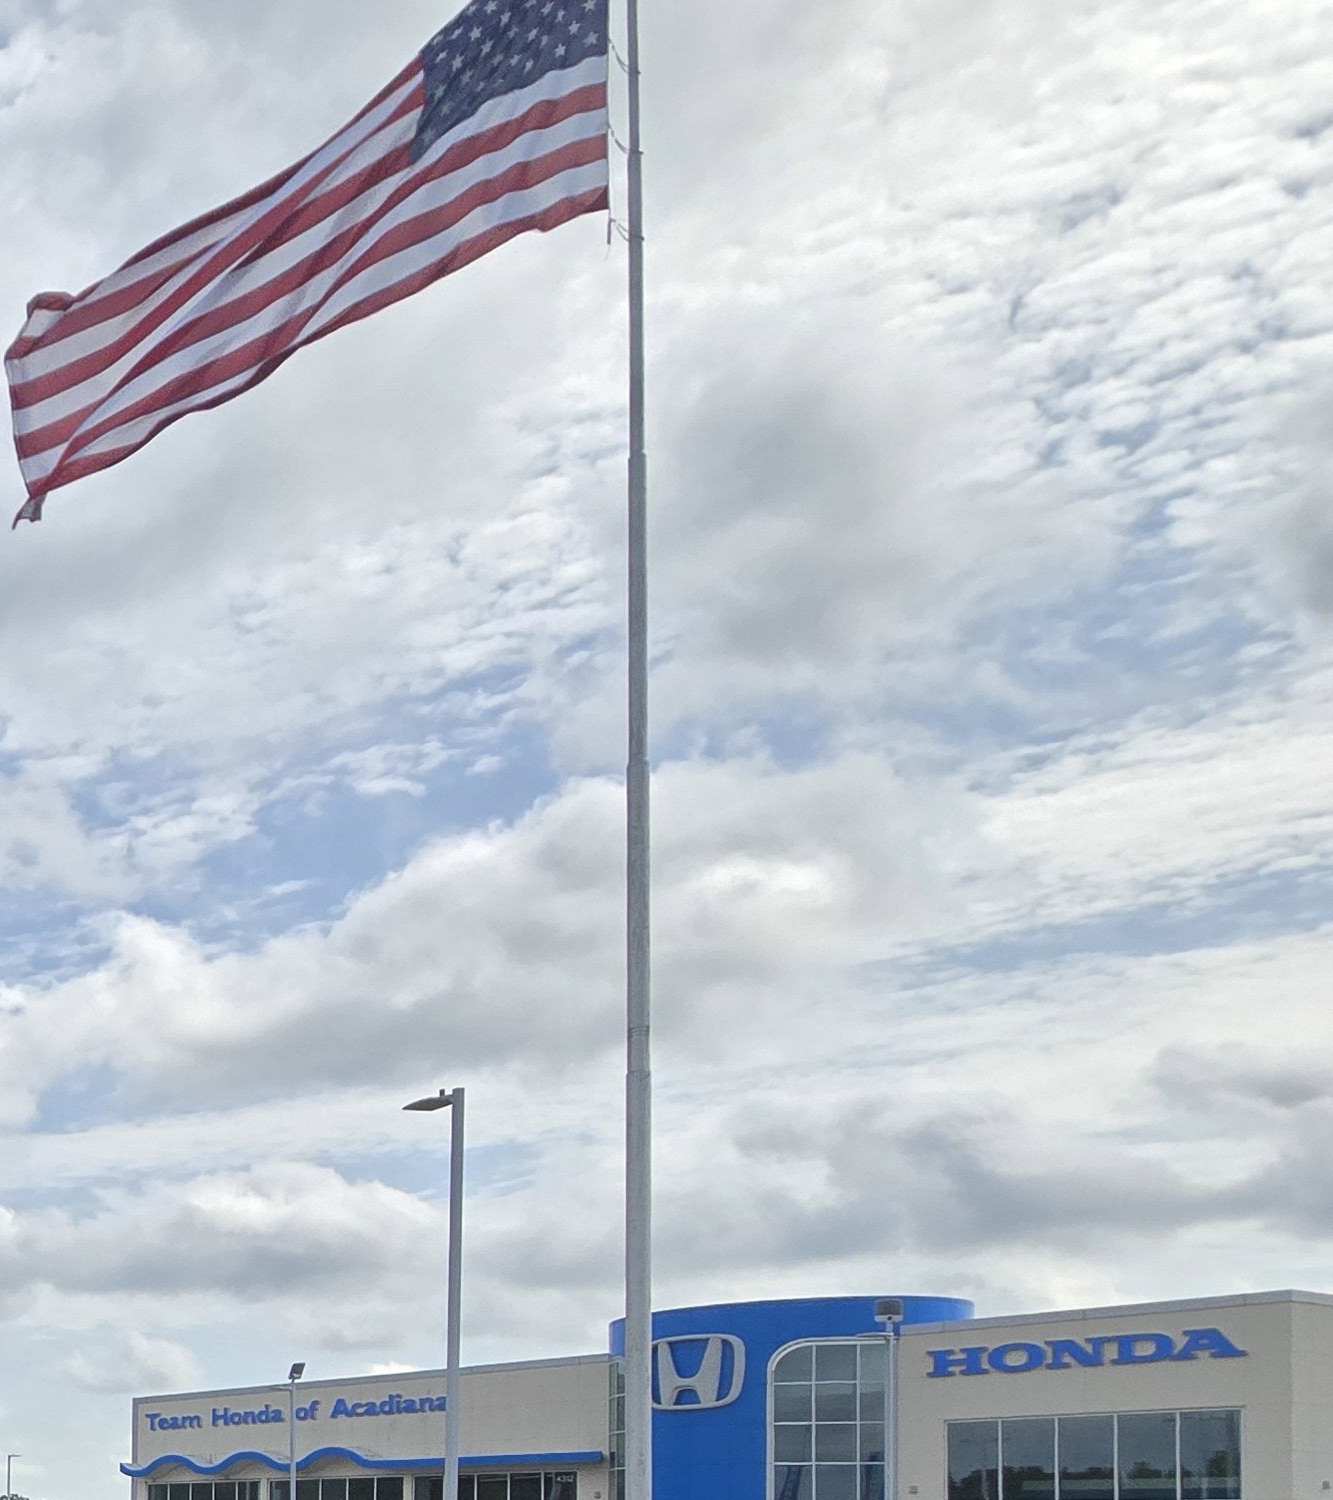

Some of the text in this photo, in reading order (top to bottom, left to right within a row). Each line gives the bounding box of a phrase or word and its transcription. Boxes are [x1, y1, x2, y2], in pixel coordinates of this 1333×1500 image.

[926, 1328, 1247, 1377] HONDA
[145, 1394, 447, 1431] Team Honda of Acadiana
